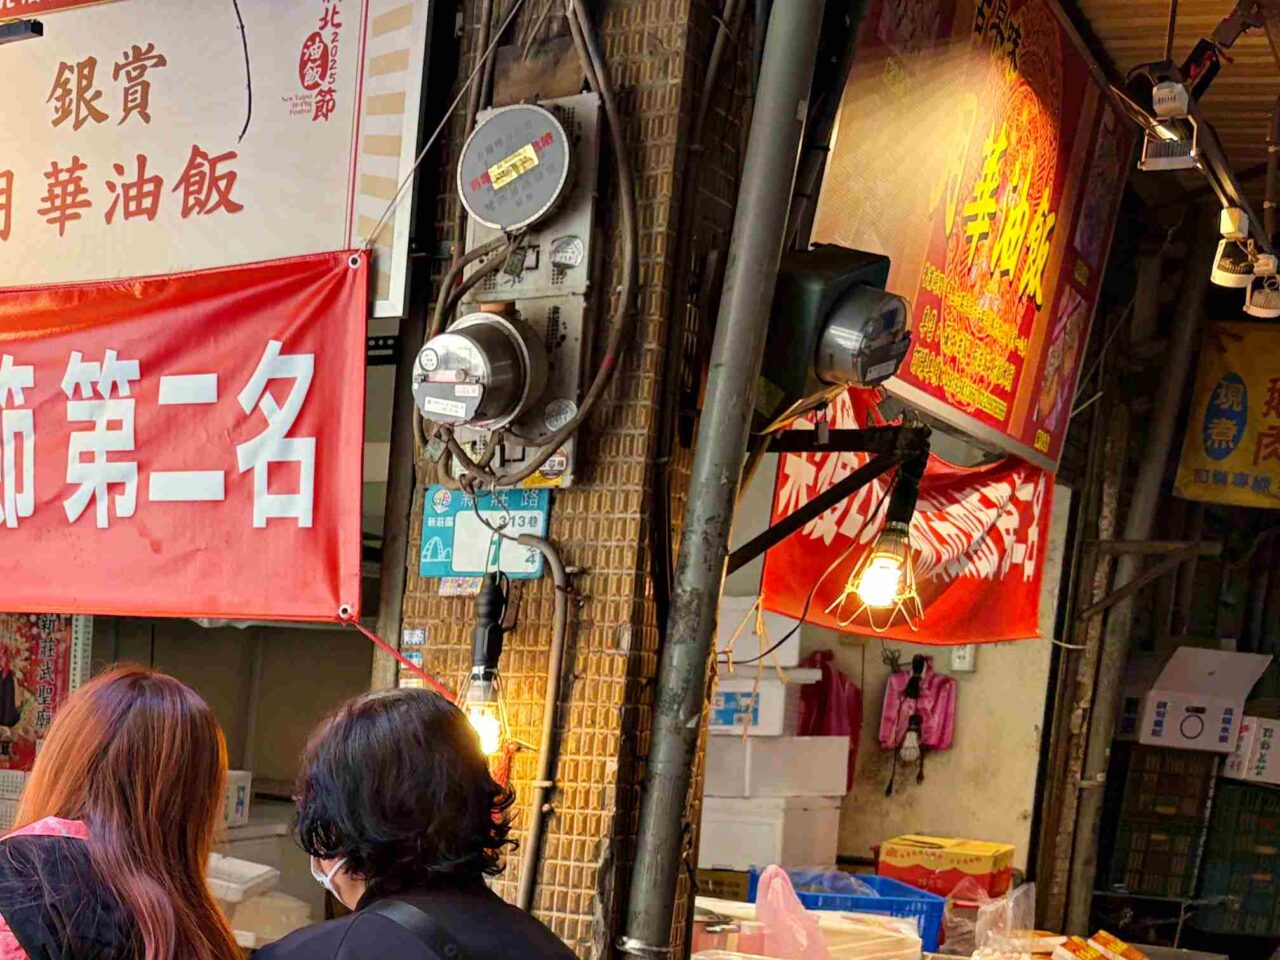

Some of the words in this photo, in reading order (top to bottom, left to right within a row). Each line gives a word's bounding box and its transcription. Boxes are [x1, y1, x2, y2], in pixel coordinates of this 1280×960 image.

[46, 43, 167, 131] 銀賞
[58, 339, 317, 530] 第二名
